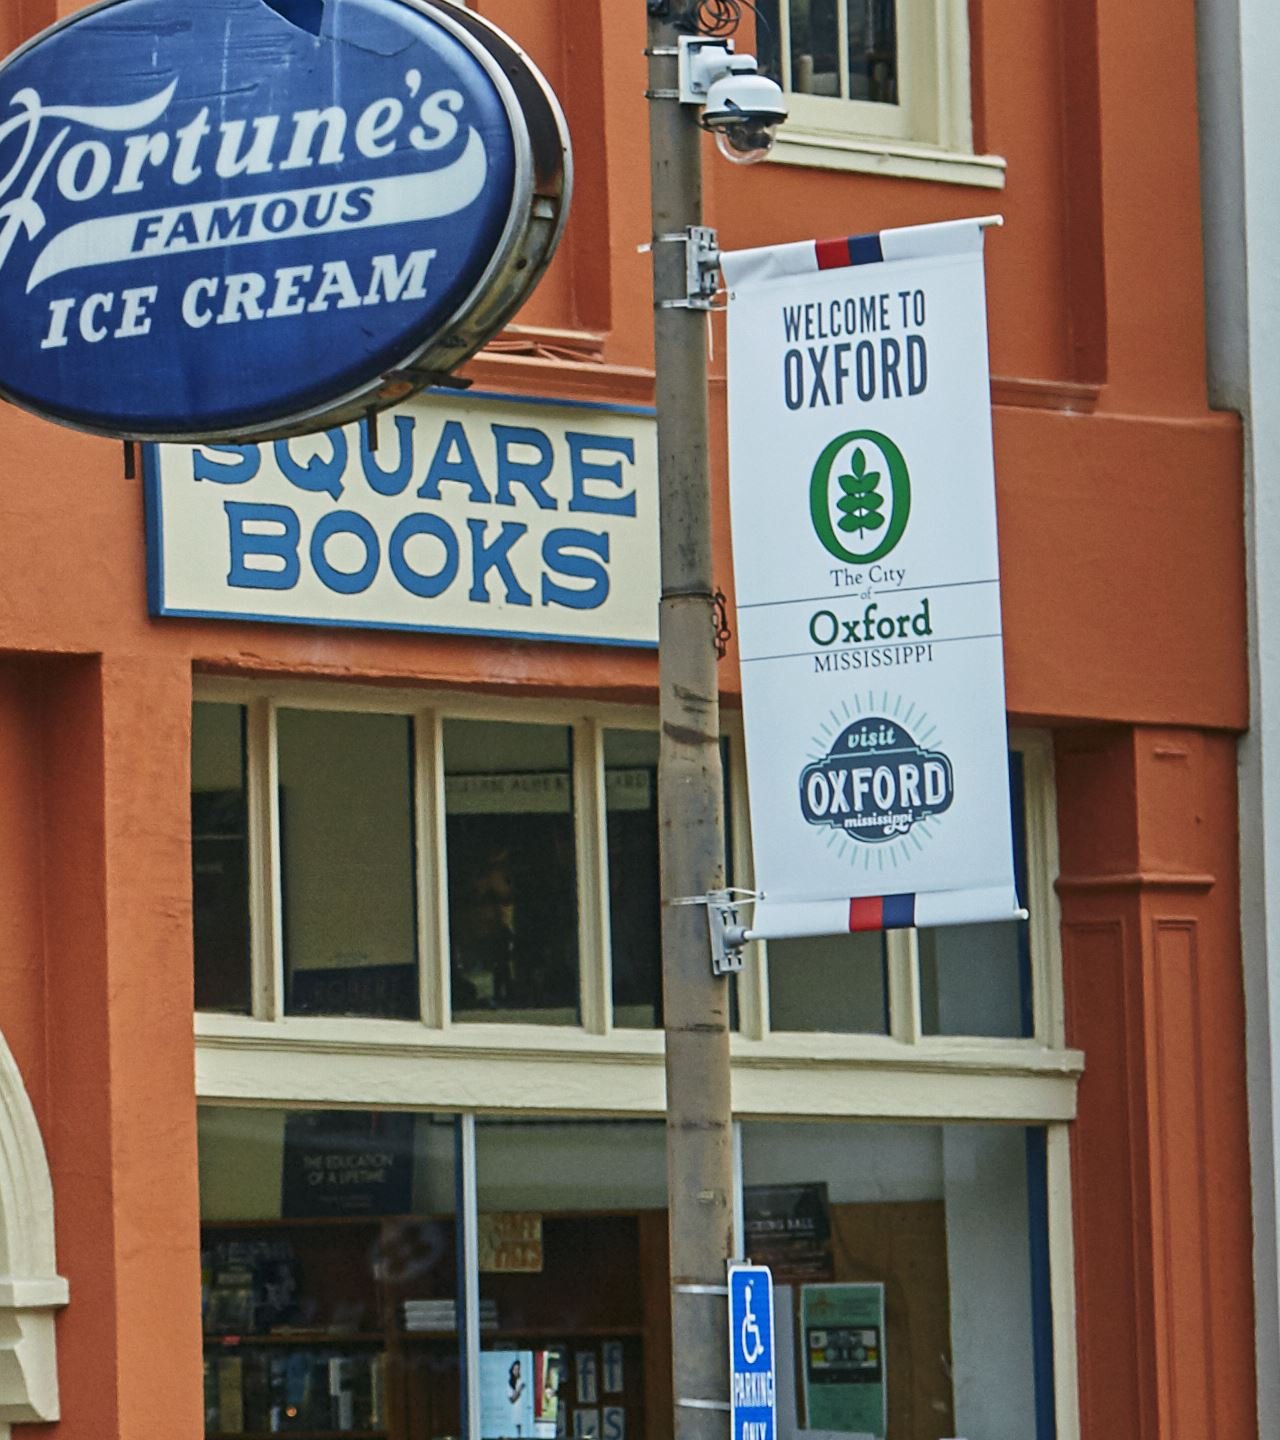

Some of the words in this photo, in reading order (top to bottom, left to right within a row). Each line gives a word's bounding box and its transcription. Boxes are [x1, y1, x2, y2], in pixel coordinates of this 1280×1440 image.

[136, 185, 375, 255] FAMOUS
[40, 284, 158, 350] ICE
[181, 249, 438, 329] CREAM
[782, 292, 891, 344] WELCOME
[897, 289, 927, 328] TO
[783, 333, 929, 411] OXFORD
[192, 415, 638, 518] SQUARE
[224, 500, 611, 611] BOOKS
[829, 566, 865, 588] The
[868, 564, 907, 590] City
[860, 587, 873, 601] of
[809, 598, 933, 648] Oxford
[813, 644, 934, 674] MISSISSIPPI
[846, 724, 897, 749] visit
[806, 759, 947, 818] OXFORD
[843, 810, 914, 835] mississippi
[733, 1371, 774, 1408] PARKING
